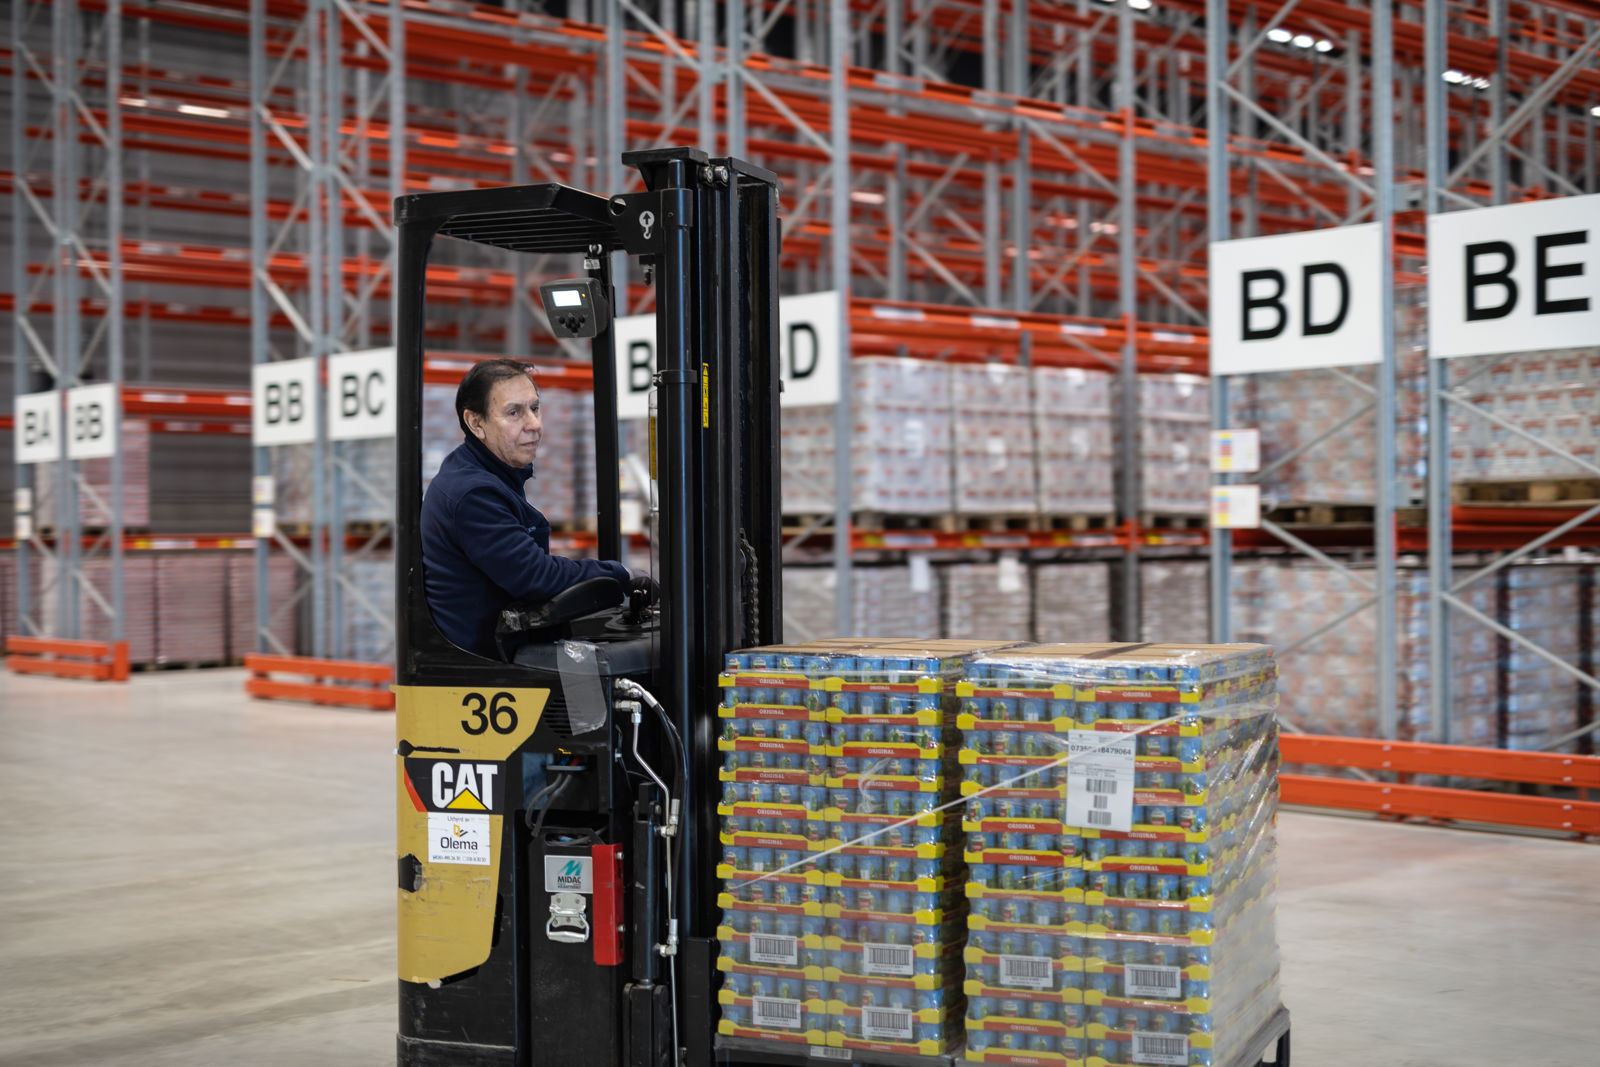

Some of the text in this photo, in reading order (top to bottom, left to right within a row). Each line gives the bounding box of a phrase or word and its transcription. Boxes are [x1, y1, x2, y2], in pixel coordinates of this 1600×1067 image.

[1464, 230, 1590, 321] BE
[1240, 262, 1350, 341] BD
[264, 382, 304, 425] BB
[340, 371, 385, 419] BC
[460, 692, 518, 736] 36
[432, 762, 498, 810] CAT
[756, 808, 782, 816] ORIGINAL
[440, 836, 478, 850] Olema
[1128, 832, 1157, 840] ORIGINAL
[1009, 854, 1037, 862] ORIGINAL
[557, 876, 582, 884] MIDAC
[1010, 1024, 1038, 1032] ORIGINAL
